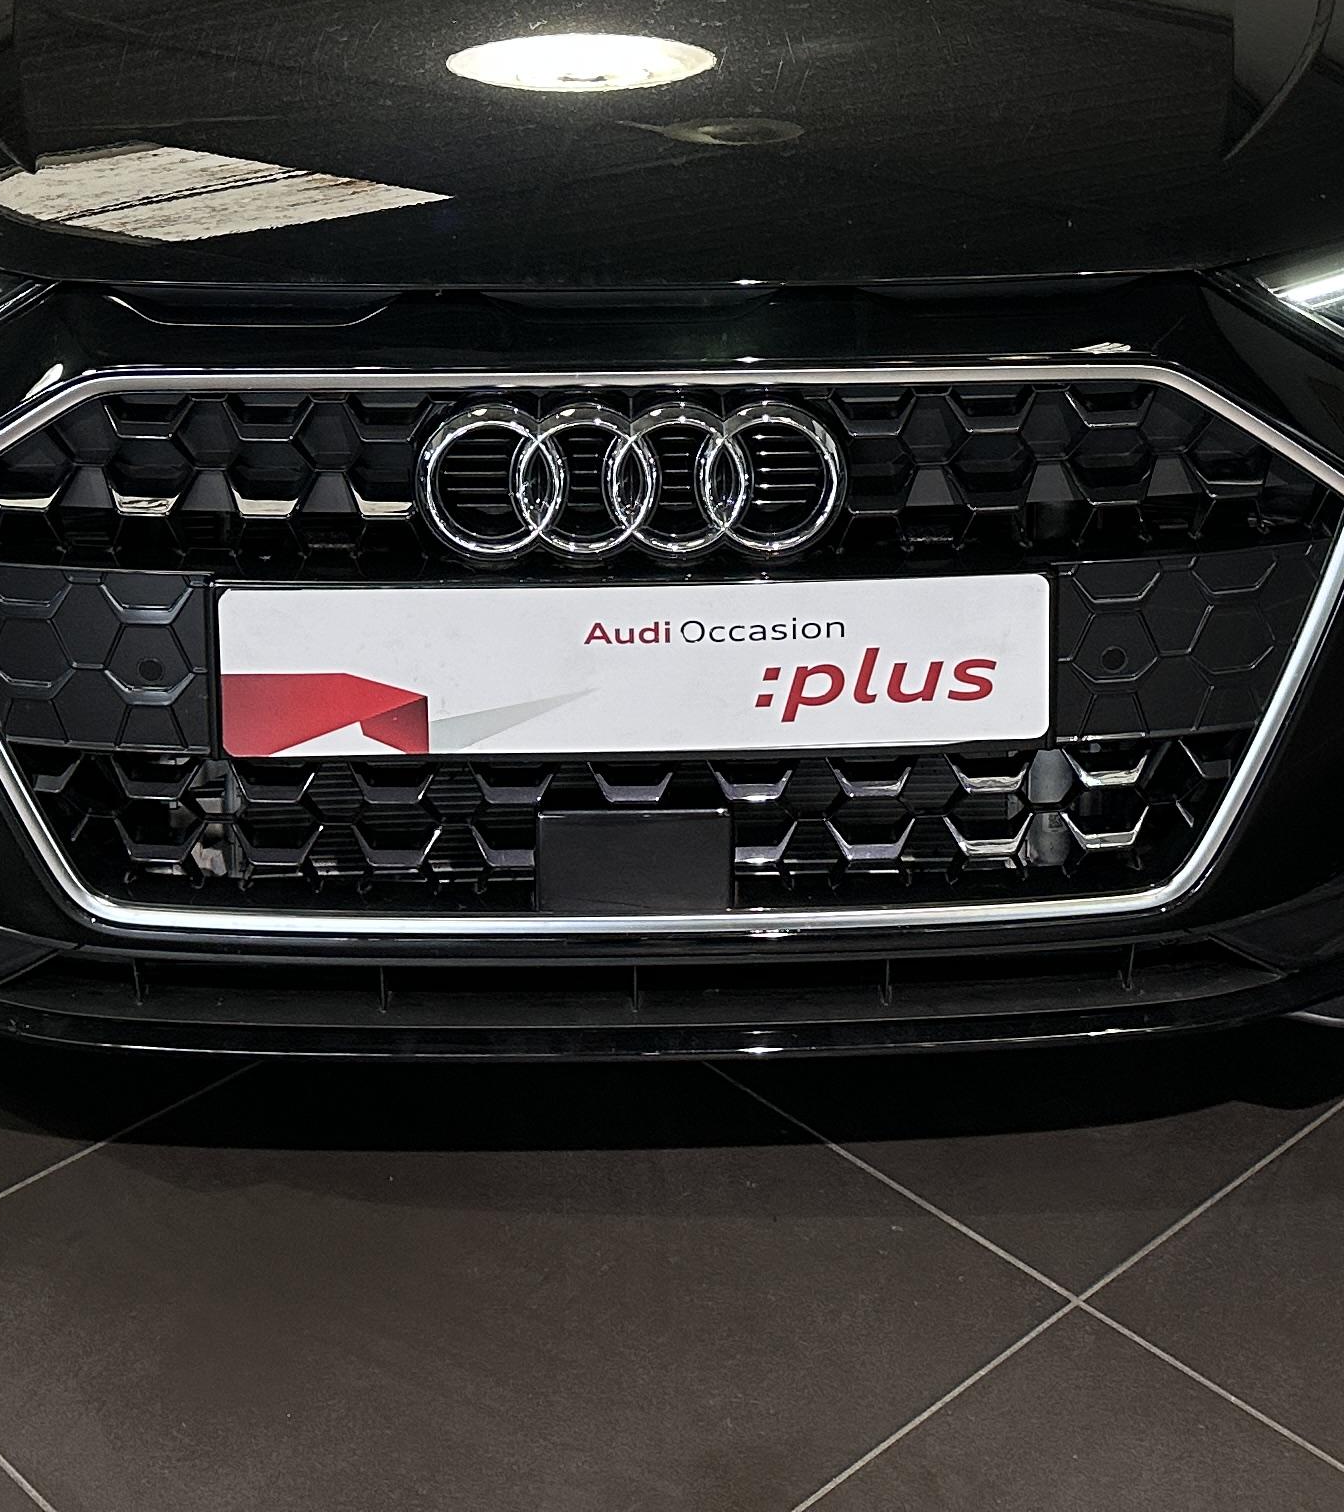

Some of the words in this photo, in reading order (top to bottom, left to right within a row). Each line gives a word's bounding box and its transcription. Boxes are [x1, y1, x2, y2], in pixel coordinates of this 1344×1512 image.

[584, 621, 671, 645] Audi
[680, 617, 847, 644] Occasion
[754, 647, 997, 723] :plus
